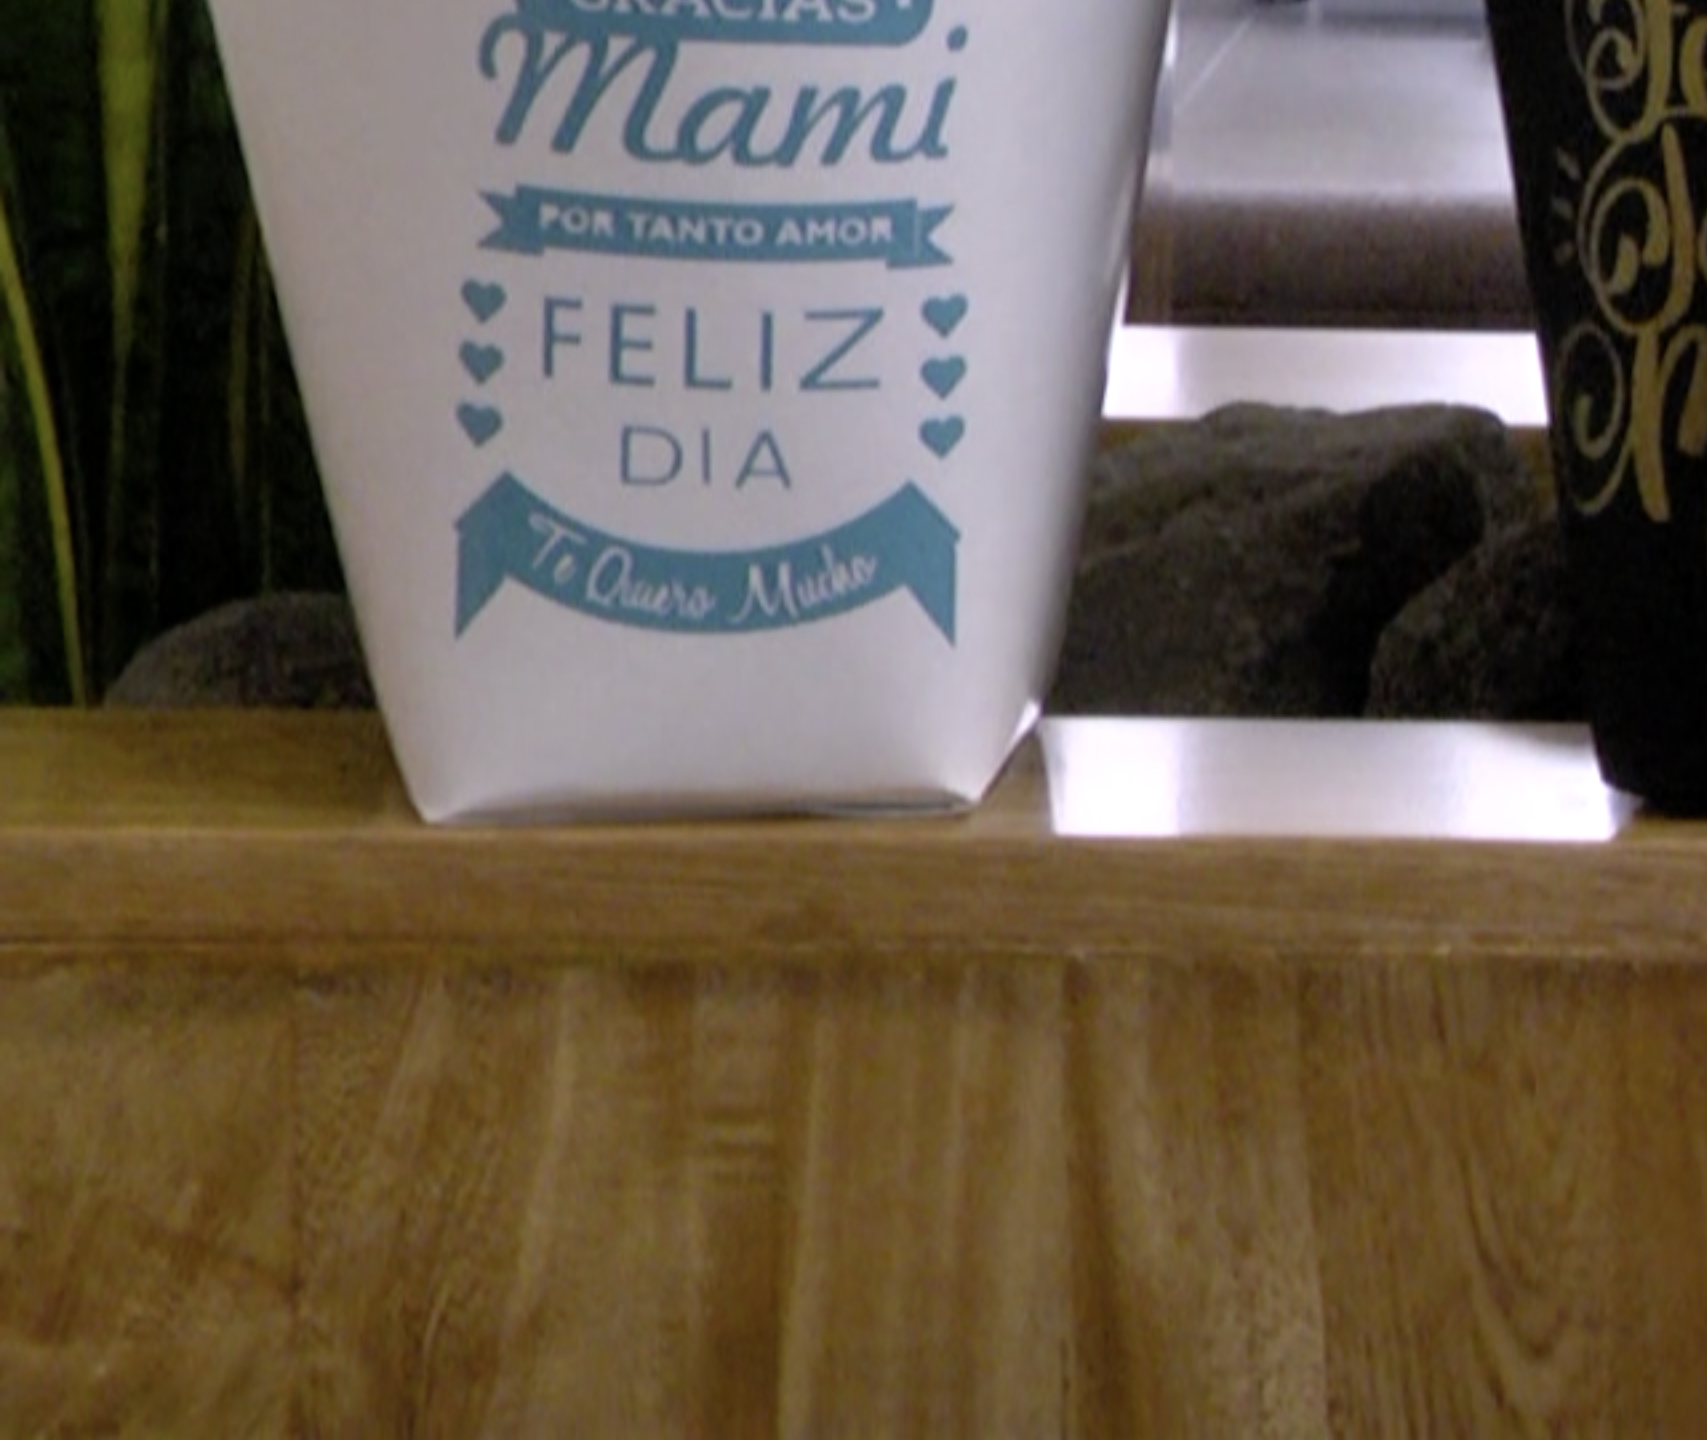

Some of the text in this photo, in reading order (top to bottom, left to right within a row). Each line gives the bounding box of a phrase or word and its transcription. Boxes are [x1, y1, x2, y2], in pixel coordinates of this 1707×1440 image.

[478, 13, 970, 168] Mami
[538, 202, 894, 248] POR TANTO AMOR
[541, 295, 886, 393] FELIZ
[620, 424, 793, 491] DIA
[528, 510, 588, 584] Te
[726, 543, 878, 624] Mucho
